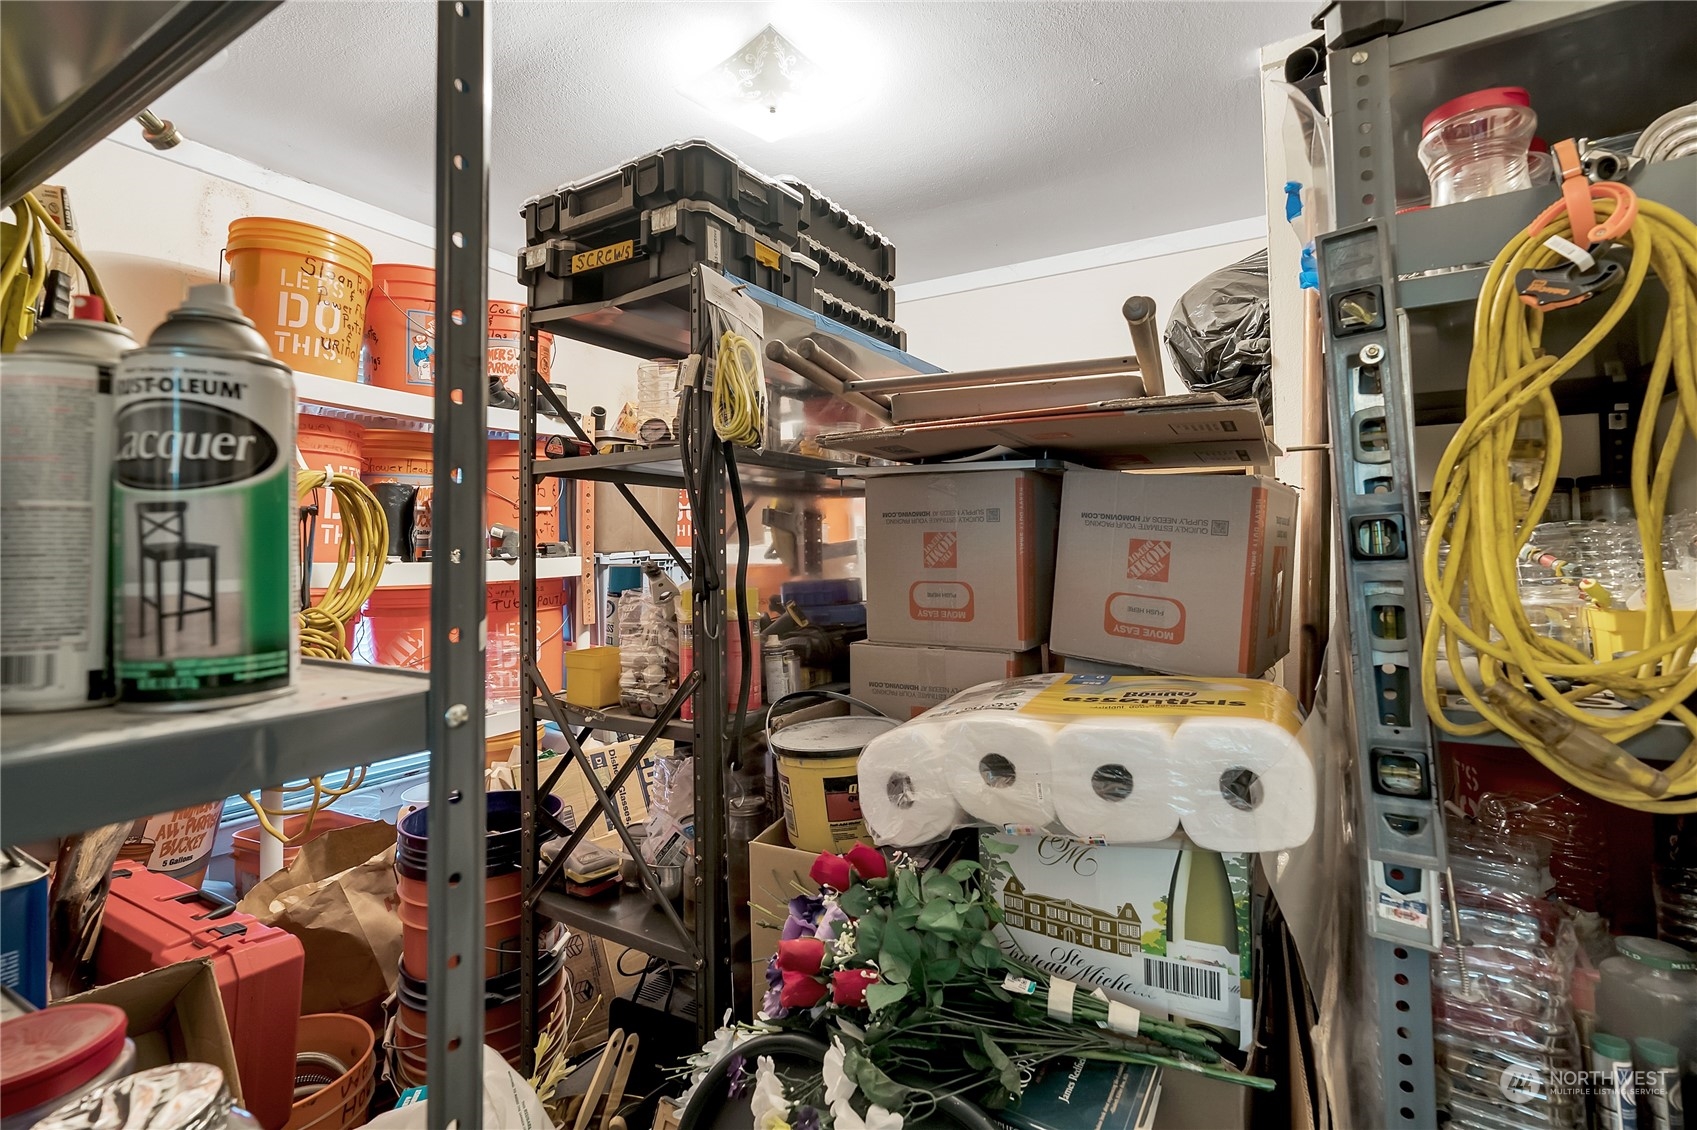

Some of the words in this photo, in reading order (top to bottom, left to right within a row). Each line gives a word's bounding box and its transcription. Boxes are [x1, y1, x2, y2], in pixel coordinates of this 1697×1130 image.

[278, 291, 341, 334] DO
[114, 428, 257, 474] acquer
[361, 457, 403, 473] Shower
[882, 510, 930, 518] HDMOVING.COM
[960, 508, 984, 516] SUPPLY
[1080, 512, 1140, 522] HDMOVING.COM
[1152, 516, 1178, 524] NEEDS
[1178, 518, 1208, 526] SUPPLY
[1084, 520, 1114, 529] PACKING
[1116, 522, 1136, 530] YOUR
[1138, 524, 1174, 532] ESTIMATE
[1174, 526, 1208, 534] QUICKLY
[1128, 540, 1154, 563] DEPOT
[1127, 541, 1171, 580] HOME
[1144, 562, 1164, 577] THE
[918, 609, 938, 618] EASY
[941, 610, 966, 618] MOVE
[1127, 606, 1144, 614] HERE
[1146, 608, 1164, 616] PUSH
[1112, 624, 1140, 636] EASY
[1143, 628, 1174, 640] MOVE
[868, 682, 919, 691] HDMOVING.COM
[1062, 696, 1247, 706] essentials
[158, 832, 208, 858] BUCKET
[168, 854, 193, 866] Gallons
[1058, 1080, 1076, 1104] James
